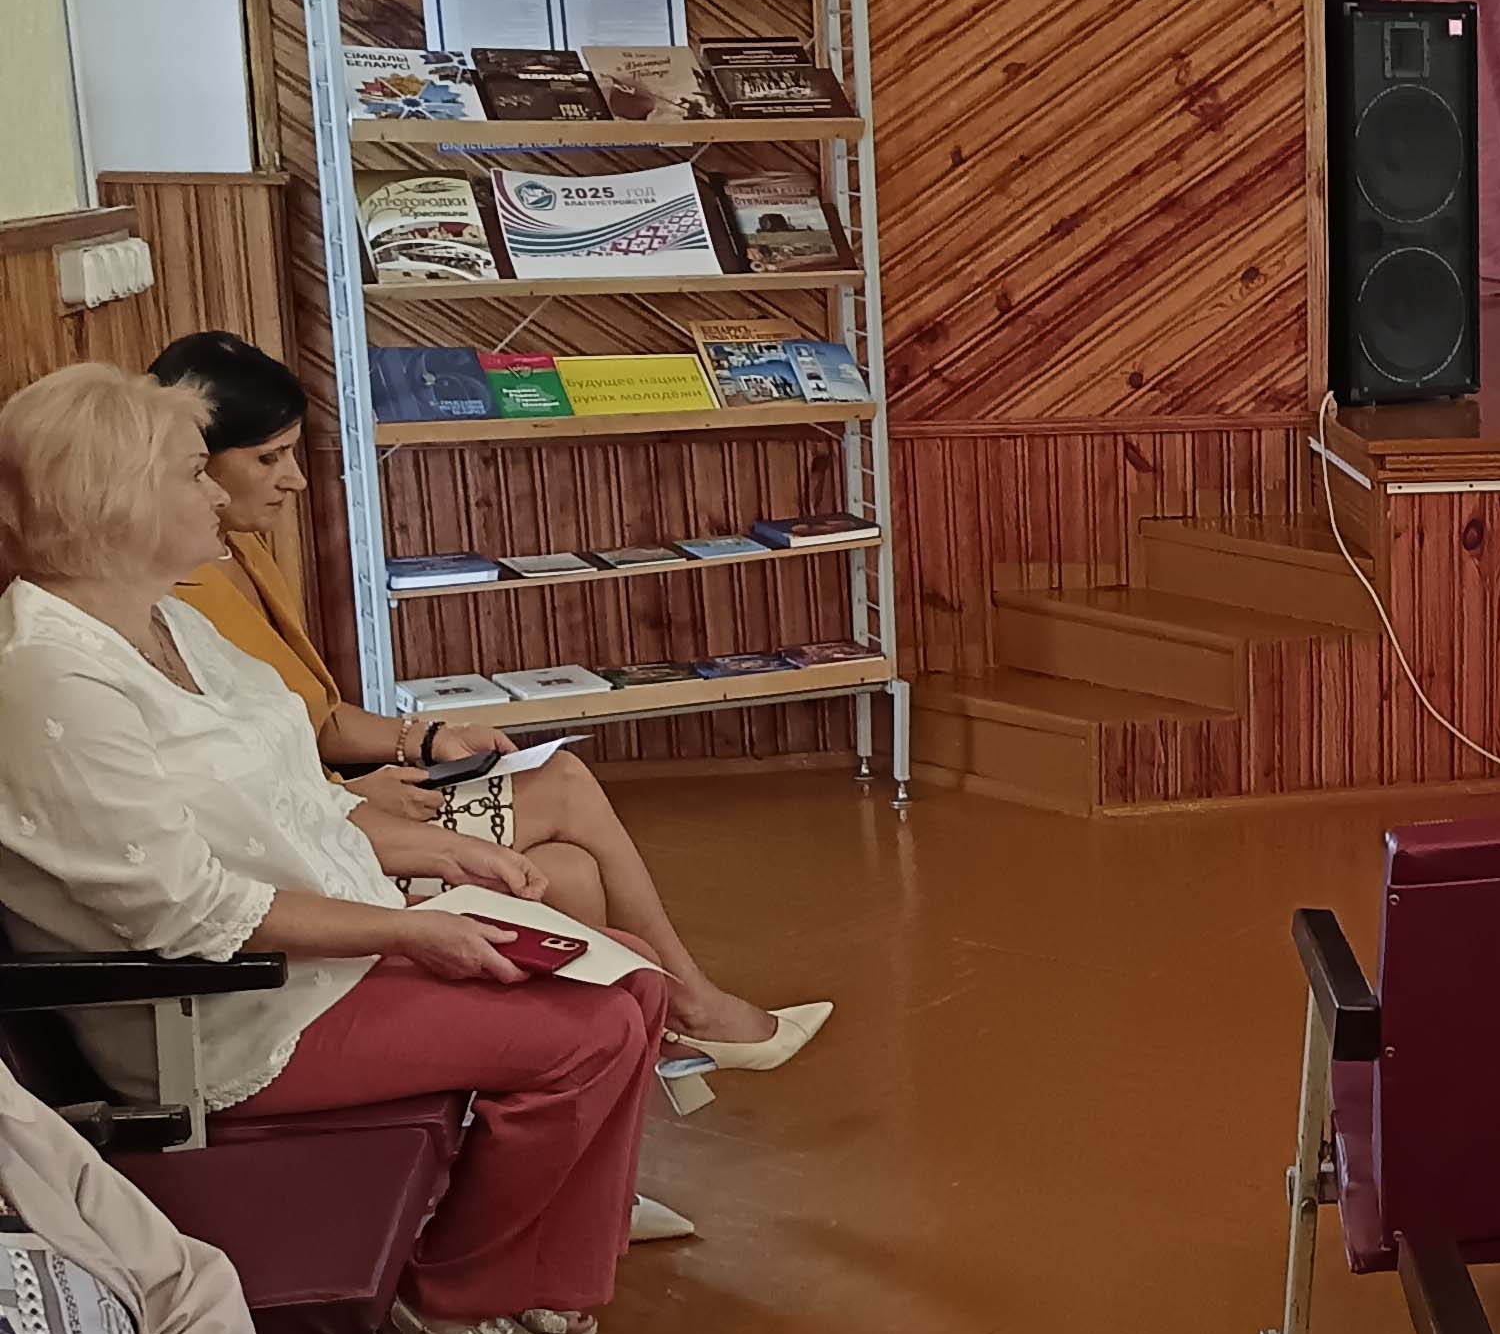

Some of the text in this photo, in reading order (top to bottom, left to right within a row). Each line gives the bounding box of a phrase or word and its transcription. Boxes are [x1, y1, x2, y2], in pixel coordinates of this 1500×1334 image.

[561, 186, 657, 200] 2025 ГОД
[566, 378, 635, 389] Будущее
[640, 376, 687, 386] нации
[572, 393, 617, 404] руках
